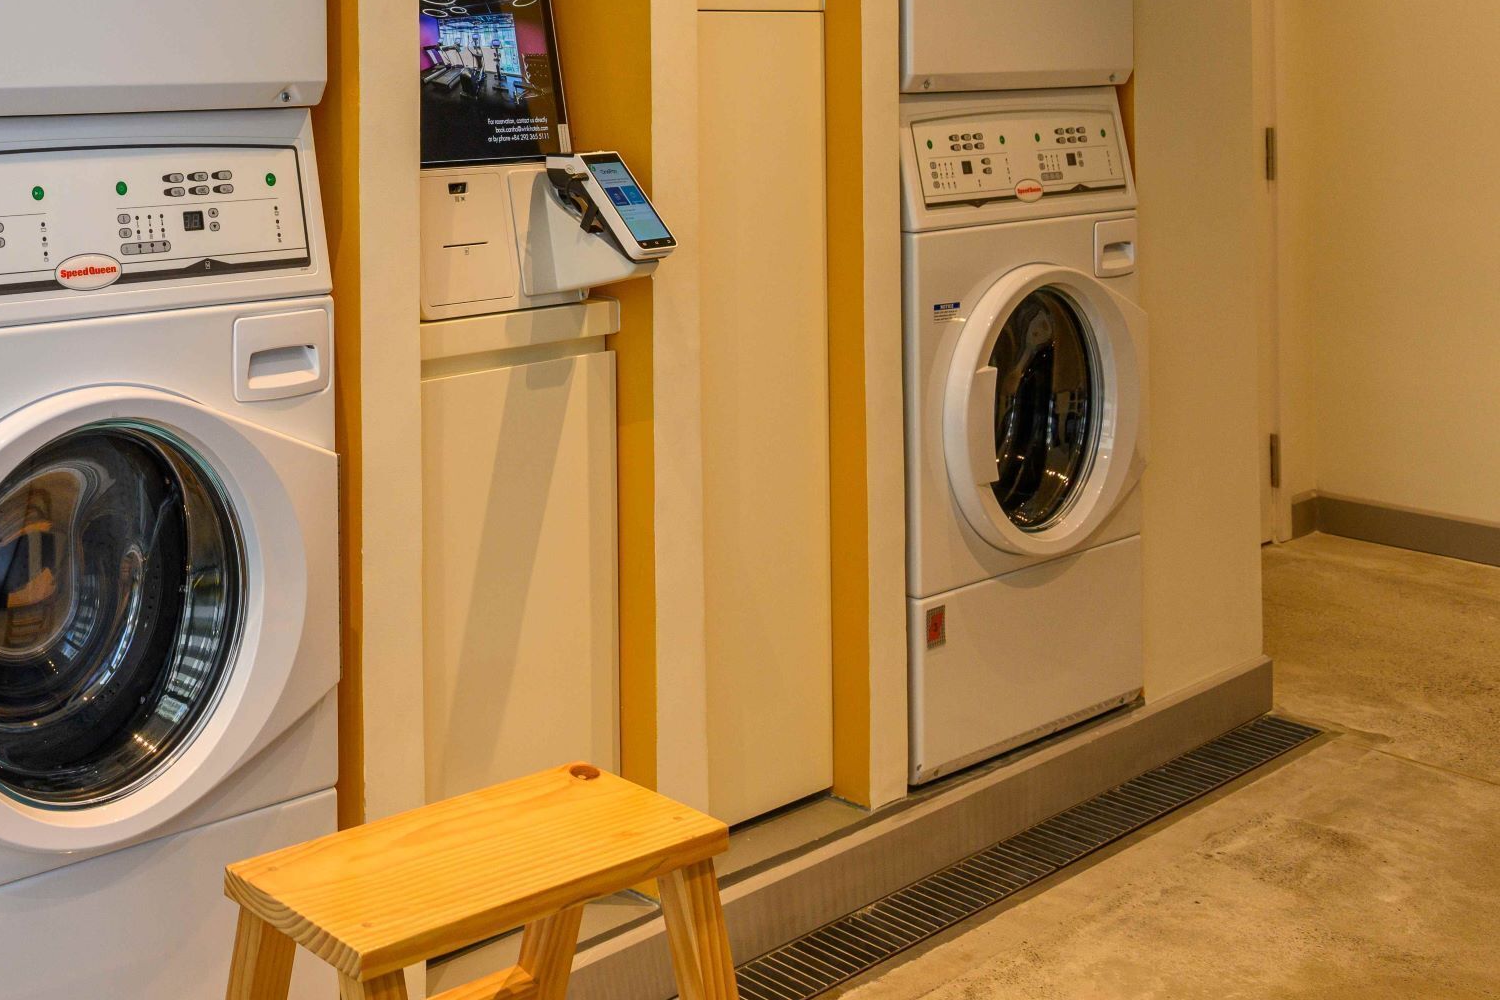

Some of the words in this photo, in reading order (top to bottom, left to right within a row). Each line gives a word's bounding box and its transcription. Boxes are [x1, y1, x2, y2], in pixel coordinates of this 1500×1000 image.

[535, 116, 547, 124] directly
[493, 135, 498, 143] by
[499, 135, 510, 143] phone
[61, 267, 88, 279] Speed
[89, 266, 116, 275] Queen
